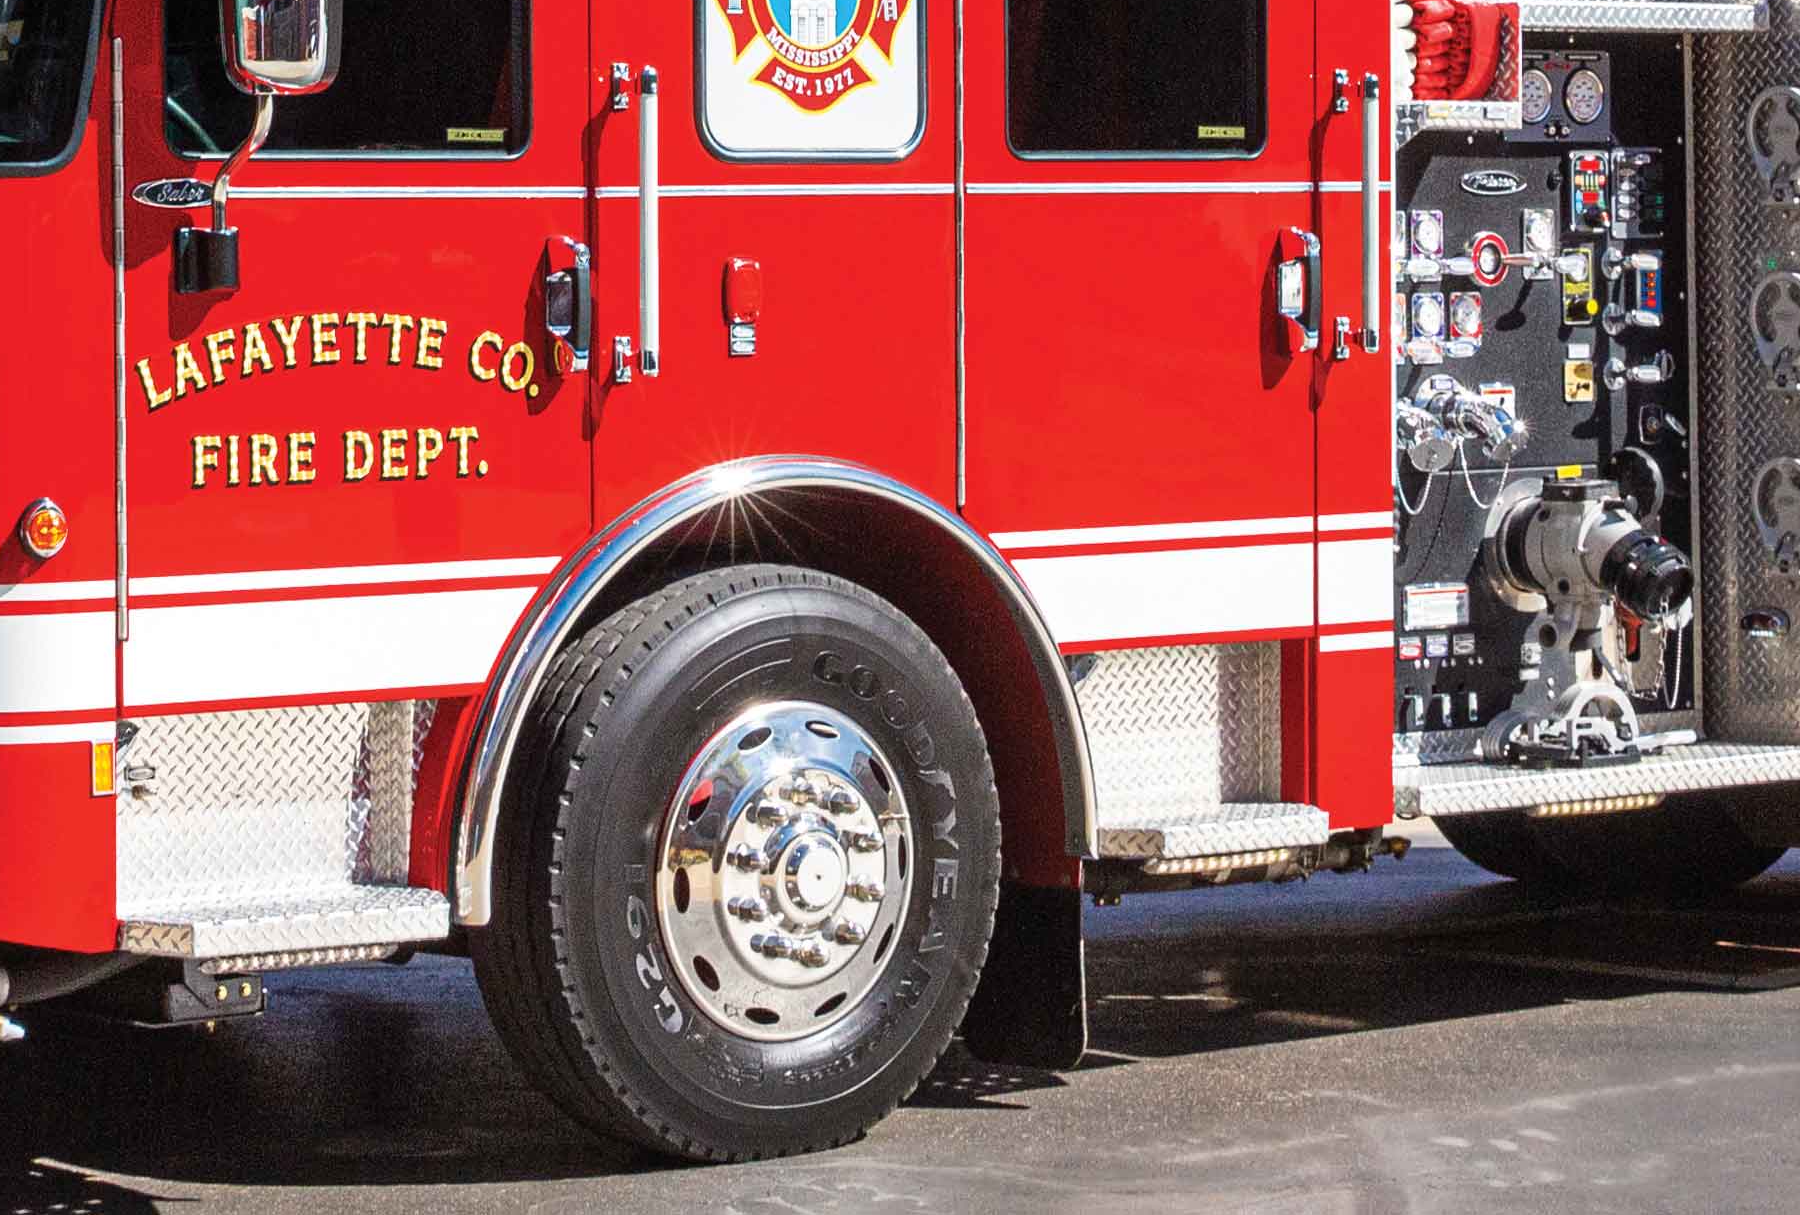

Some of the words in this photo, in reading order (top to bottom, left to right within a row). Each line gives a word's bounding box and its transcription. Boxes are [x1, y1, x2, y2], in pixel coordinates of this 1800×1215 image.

[766, 26, 861, 66] MISSISSIPPI
[771, 66, 812, 96] EST.
[815, 67, 854, 96] 1977
[136, 311, 449, 410] LAFAYETTE
[470, 329, 540, 398] CO.
[192, 431, 317, 487] FIRE
[343, 426, 490, 482] DEPT.
[812, 649, 959, 1009] GOODYEAR
